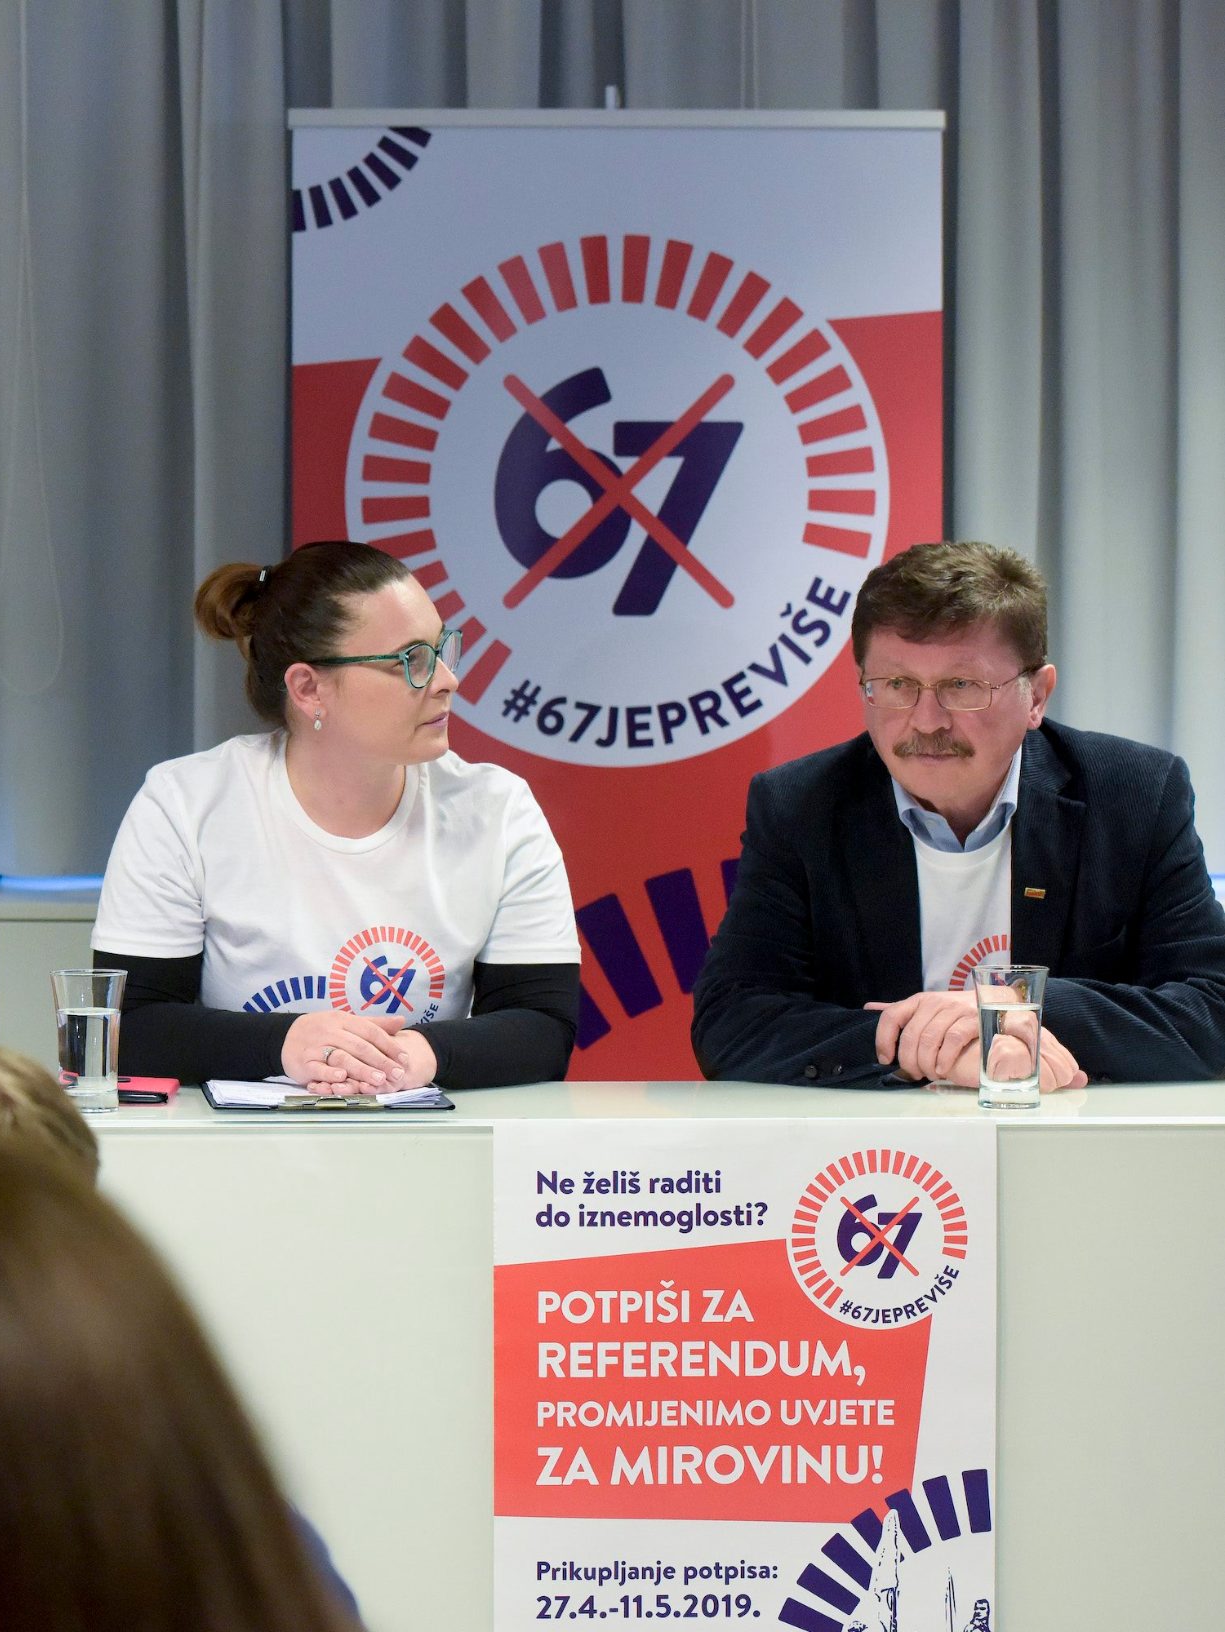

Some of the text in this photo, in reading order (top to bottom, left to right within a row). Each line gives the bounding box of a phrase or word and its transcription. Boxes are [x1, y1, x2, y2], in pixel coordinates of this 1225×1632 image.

[494, 366, 744, 616] 67
[502, 576, 852, 749] #67JEPREVIŠE
[360, 955, 417, 1013] 67
[536, 1170, 722, 1195] Ne želiš raditi
[535, 1201, 768, 1233] do iznemoglosti?
[836, 1194, 923, 1279] 67
[537, 1280, 755, 1324] POTPIŠI ZA
[839, 1264, 960, 1325] #67JEPREVIŠE
[537, 1340, 866, 1386] REFERENDUM,
[536, 1399, 895, 1428] PROMIJENIMO UVJETE
[535, 1445, 884, 1486] ZA MIROVINU!
[536, 1561, 779, 1588] Prikupljanje potpisa:
[535, 1594, 762, 1620] 27.4.-11.5.2019.
